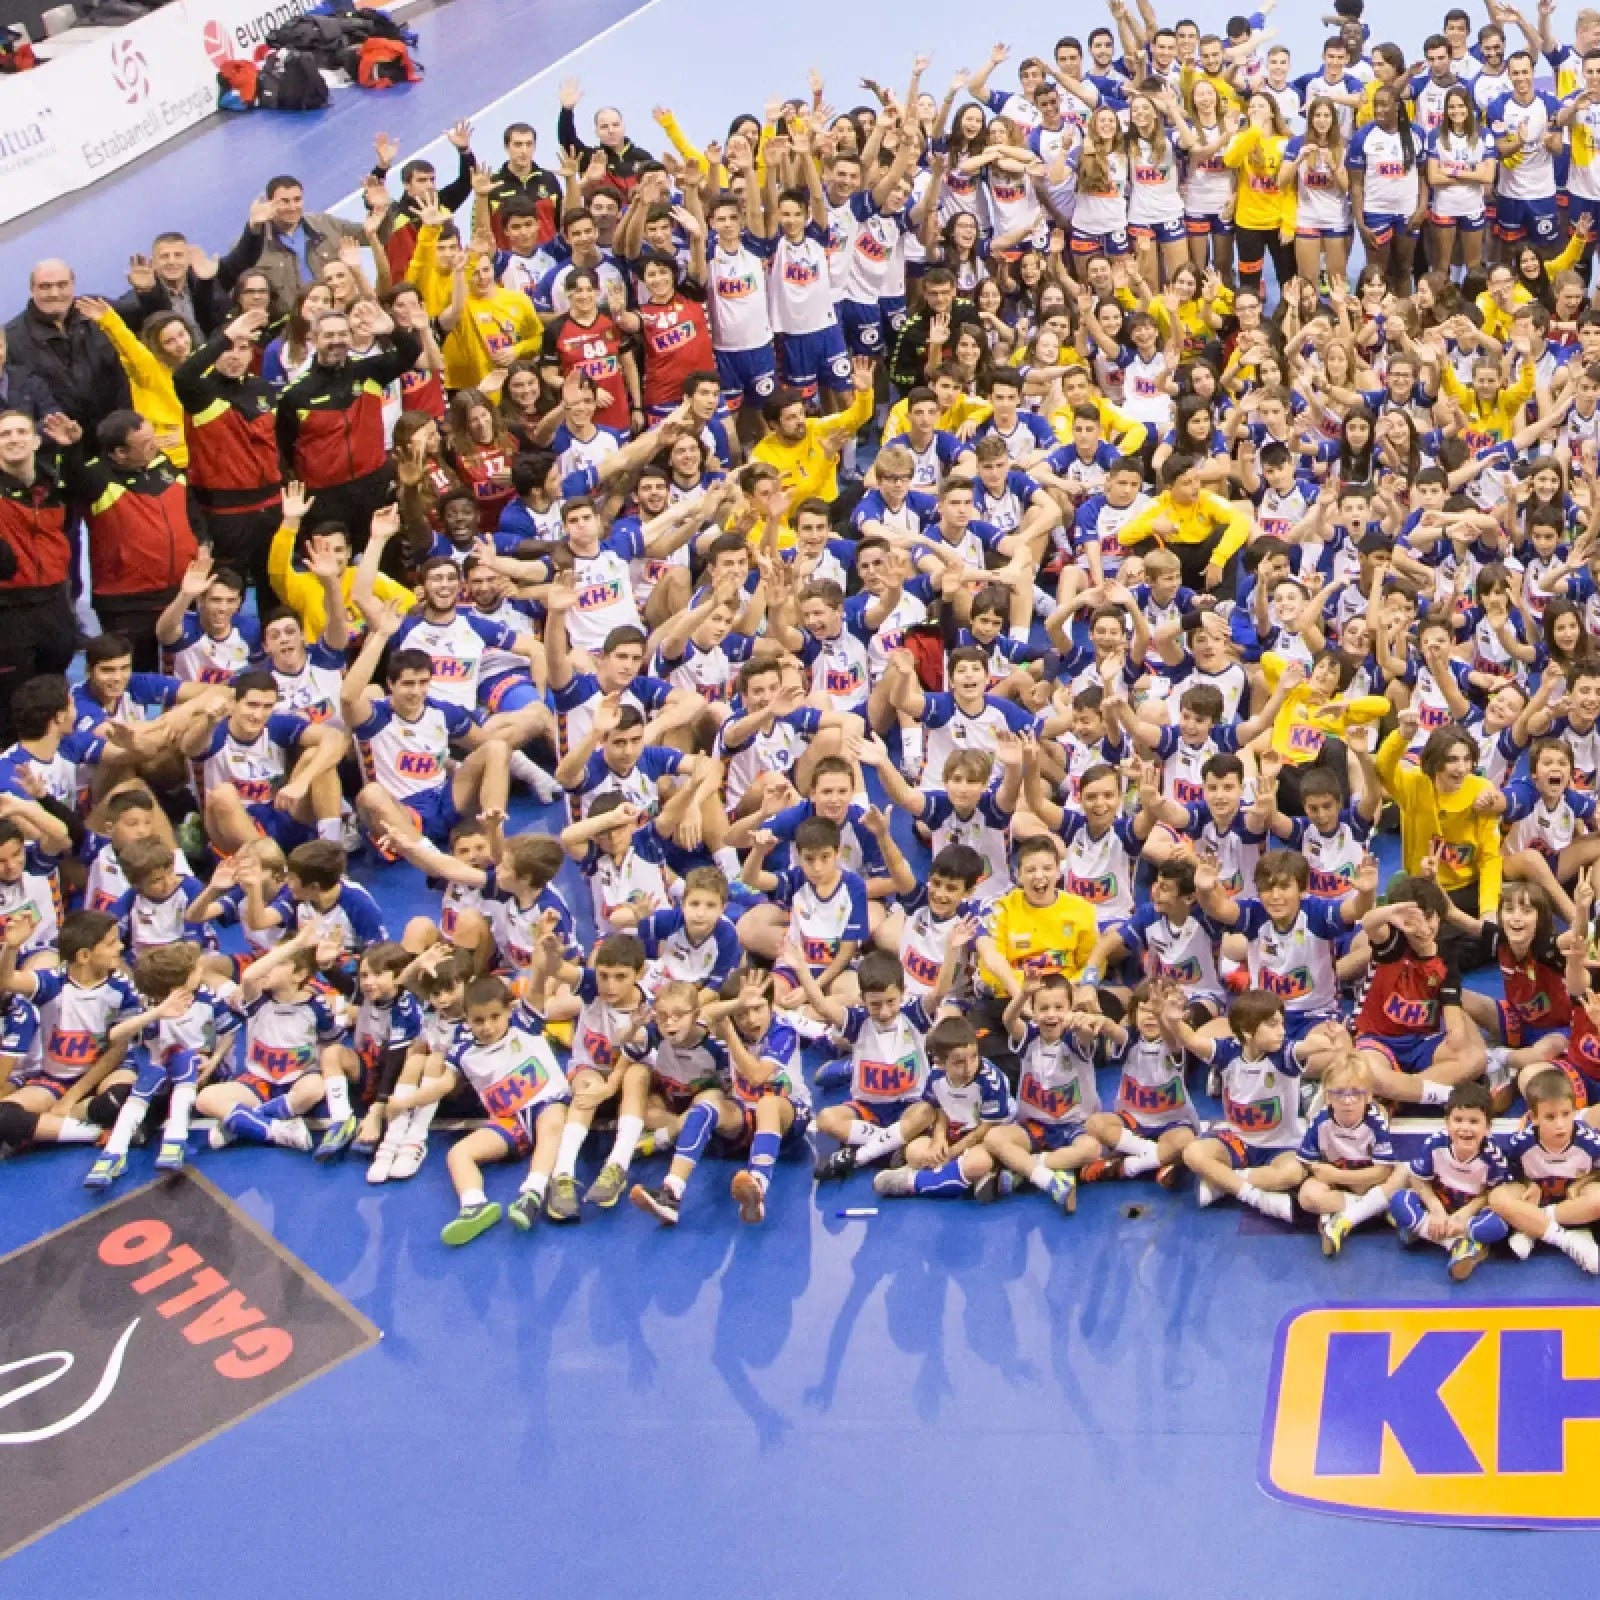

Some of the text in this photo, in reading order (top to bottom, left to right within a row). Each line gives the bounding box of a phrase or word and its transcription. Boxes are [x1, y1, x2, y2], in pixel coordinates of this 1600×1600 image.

[81, 113, 160, 169] Estabanell
[160, 84, 214, 137] Energia
[1136, 168, 1169, 182] KH-7
[1380, 163, 1404, 175] KH-
[718, 276, 756, 294] KH-7
[784, 263, 822, 283] KH-7
[653, 323, 696, 352] KH-7
[577, 580, 620, 608] KH-7
[1420, 705, 1448, 726] KH-
[1290, 728, 1323, 749] KH-
[49, 1032, 96, 1057] KH-
[864, 1064, 916, 1088] KH-7
[487, 1065, 541, 1112] KH-7
[1026, 1084, 1077, 1110] KH-7
[1125, 1082, 1184, 1105] KH-7
[98, 1219, 293, 1379] GALLO
